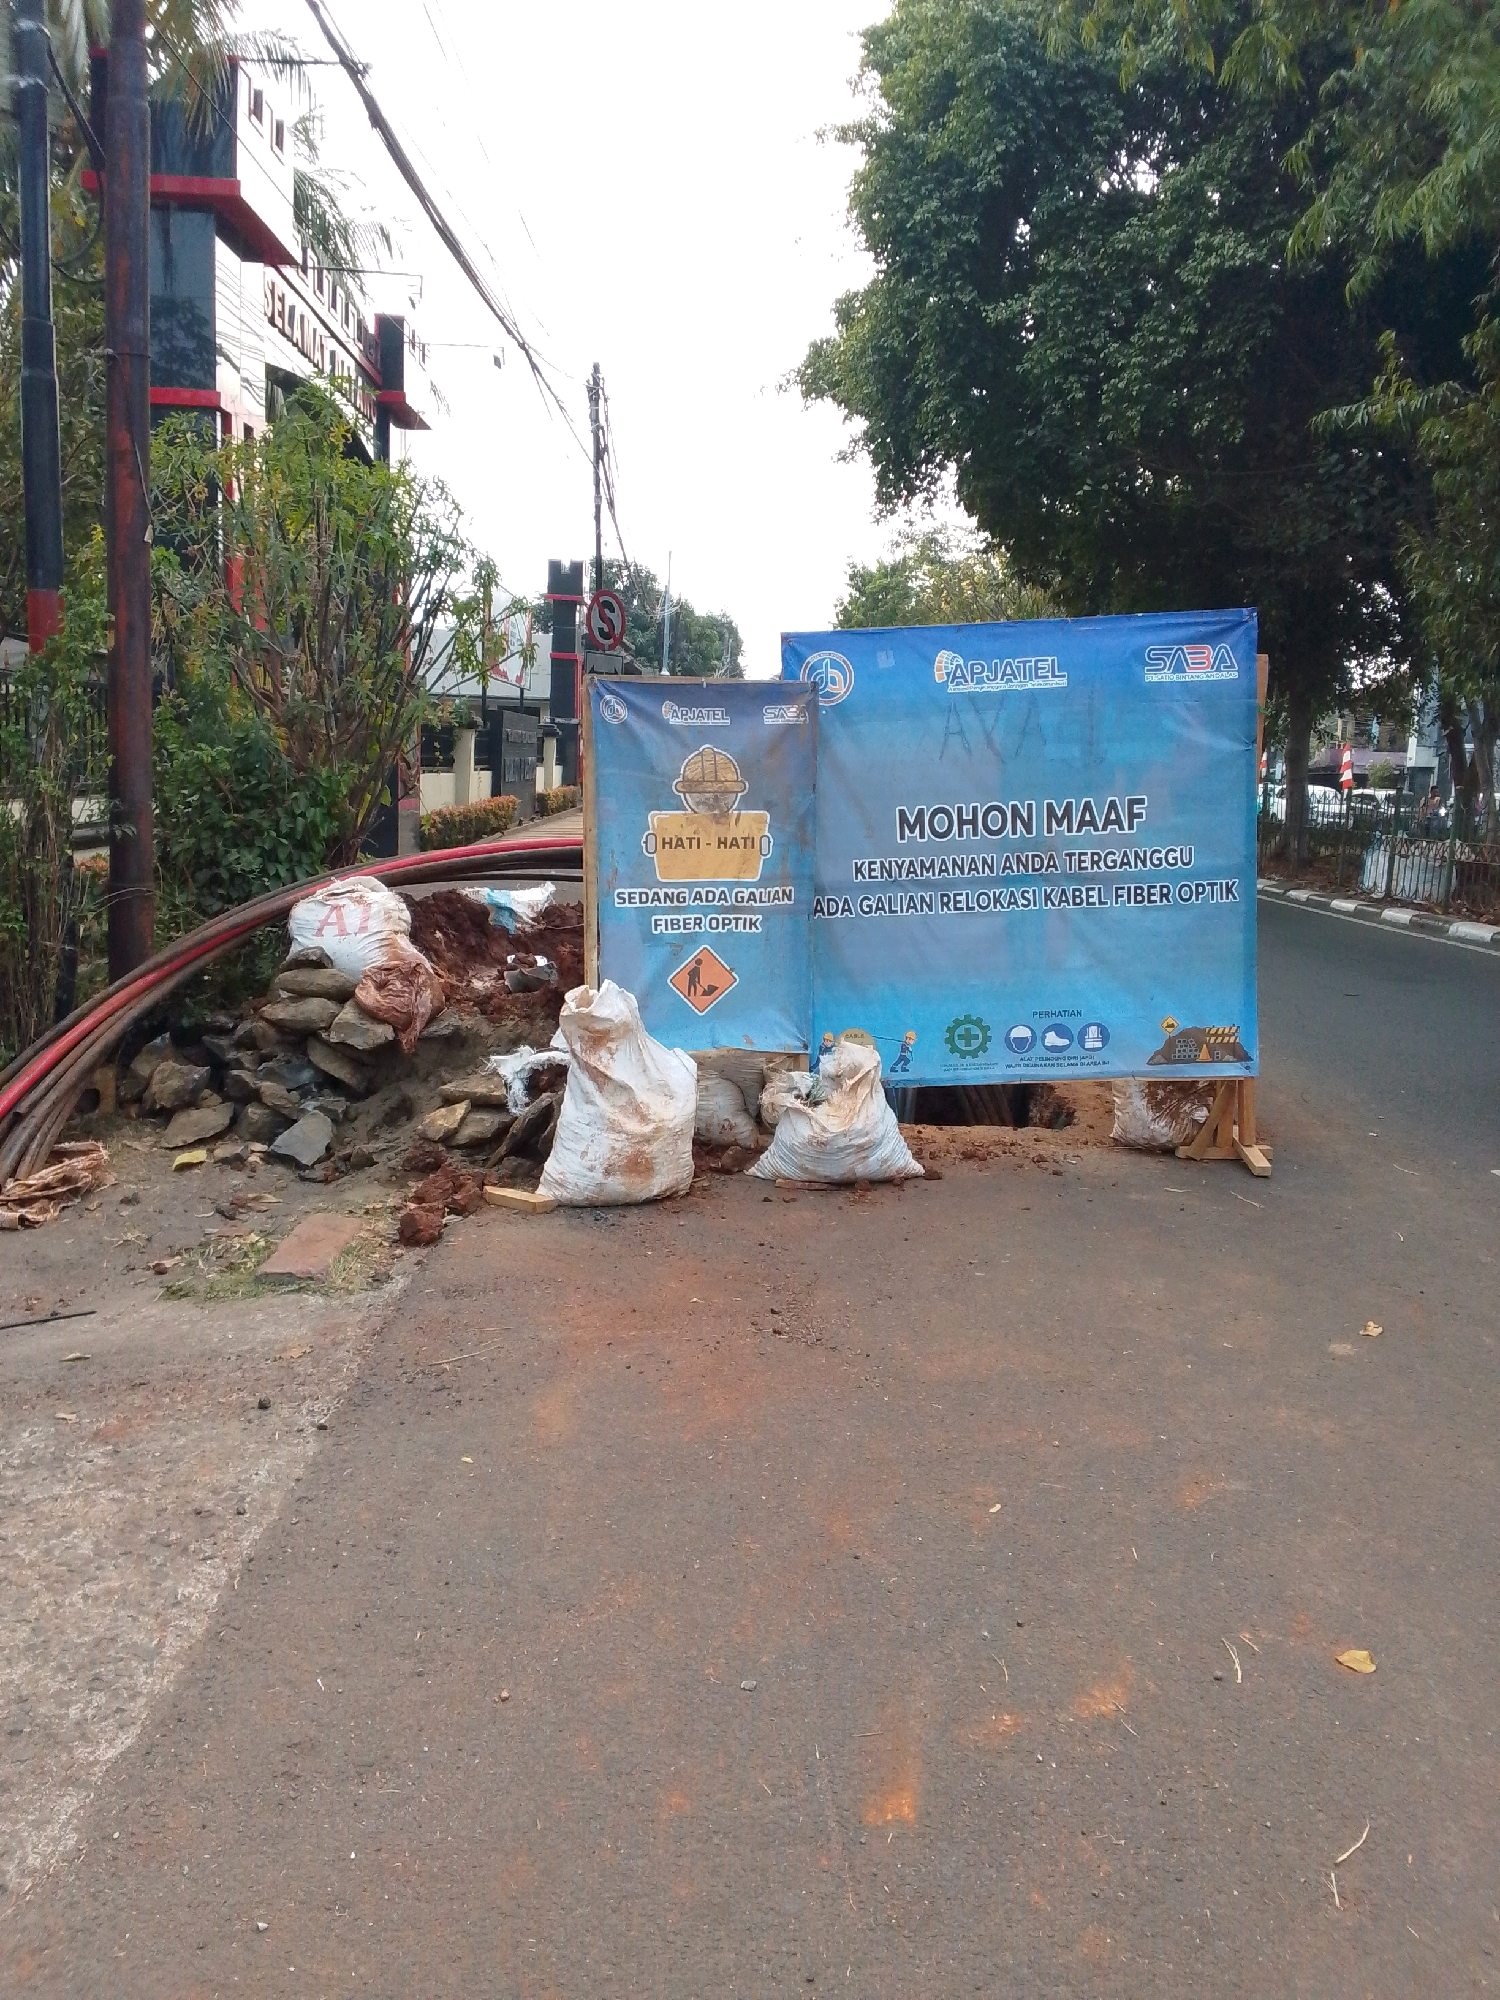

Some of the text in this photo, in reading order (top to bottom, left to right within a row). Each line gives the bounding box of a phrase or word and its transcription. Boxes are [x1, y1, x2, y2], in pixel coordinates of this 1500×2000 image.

[264, 279, 328, 374] SELAMAT
[948, 657, 1067, 685] APJATEL
[1145, 644, 1238, 673] SABA
[670, 708, 730, 721] APJATEL
[897, 797, 1146, 841] MOHON MAAF
[661, 836, 701, 850] HATI
[717, 836, 755, 850] HATI
[854, 847, 1194, 881] KENYAMANAN ANDA TERGANGGU
[616, 887, 793, 906] SEDANG ADA GALIAN
[814, 881, 1238, 918] ADA GALIAN RELOKASI KABEL FIBER OPTIK
[653, 915, 761, 932] FIBER OPTIK
[1032, 1009, 1082, 1019] PERHATIAN
